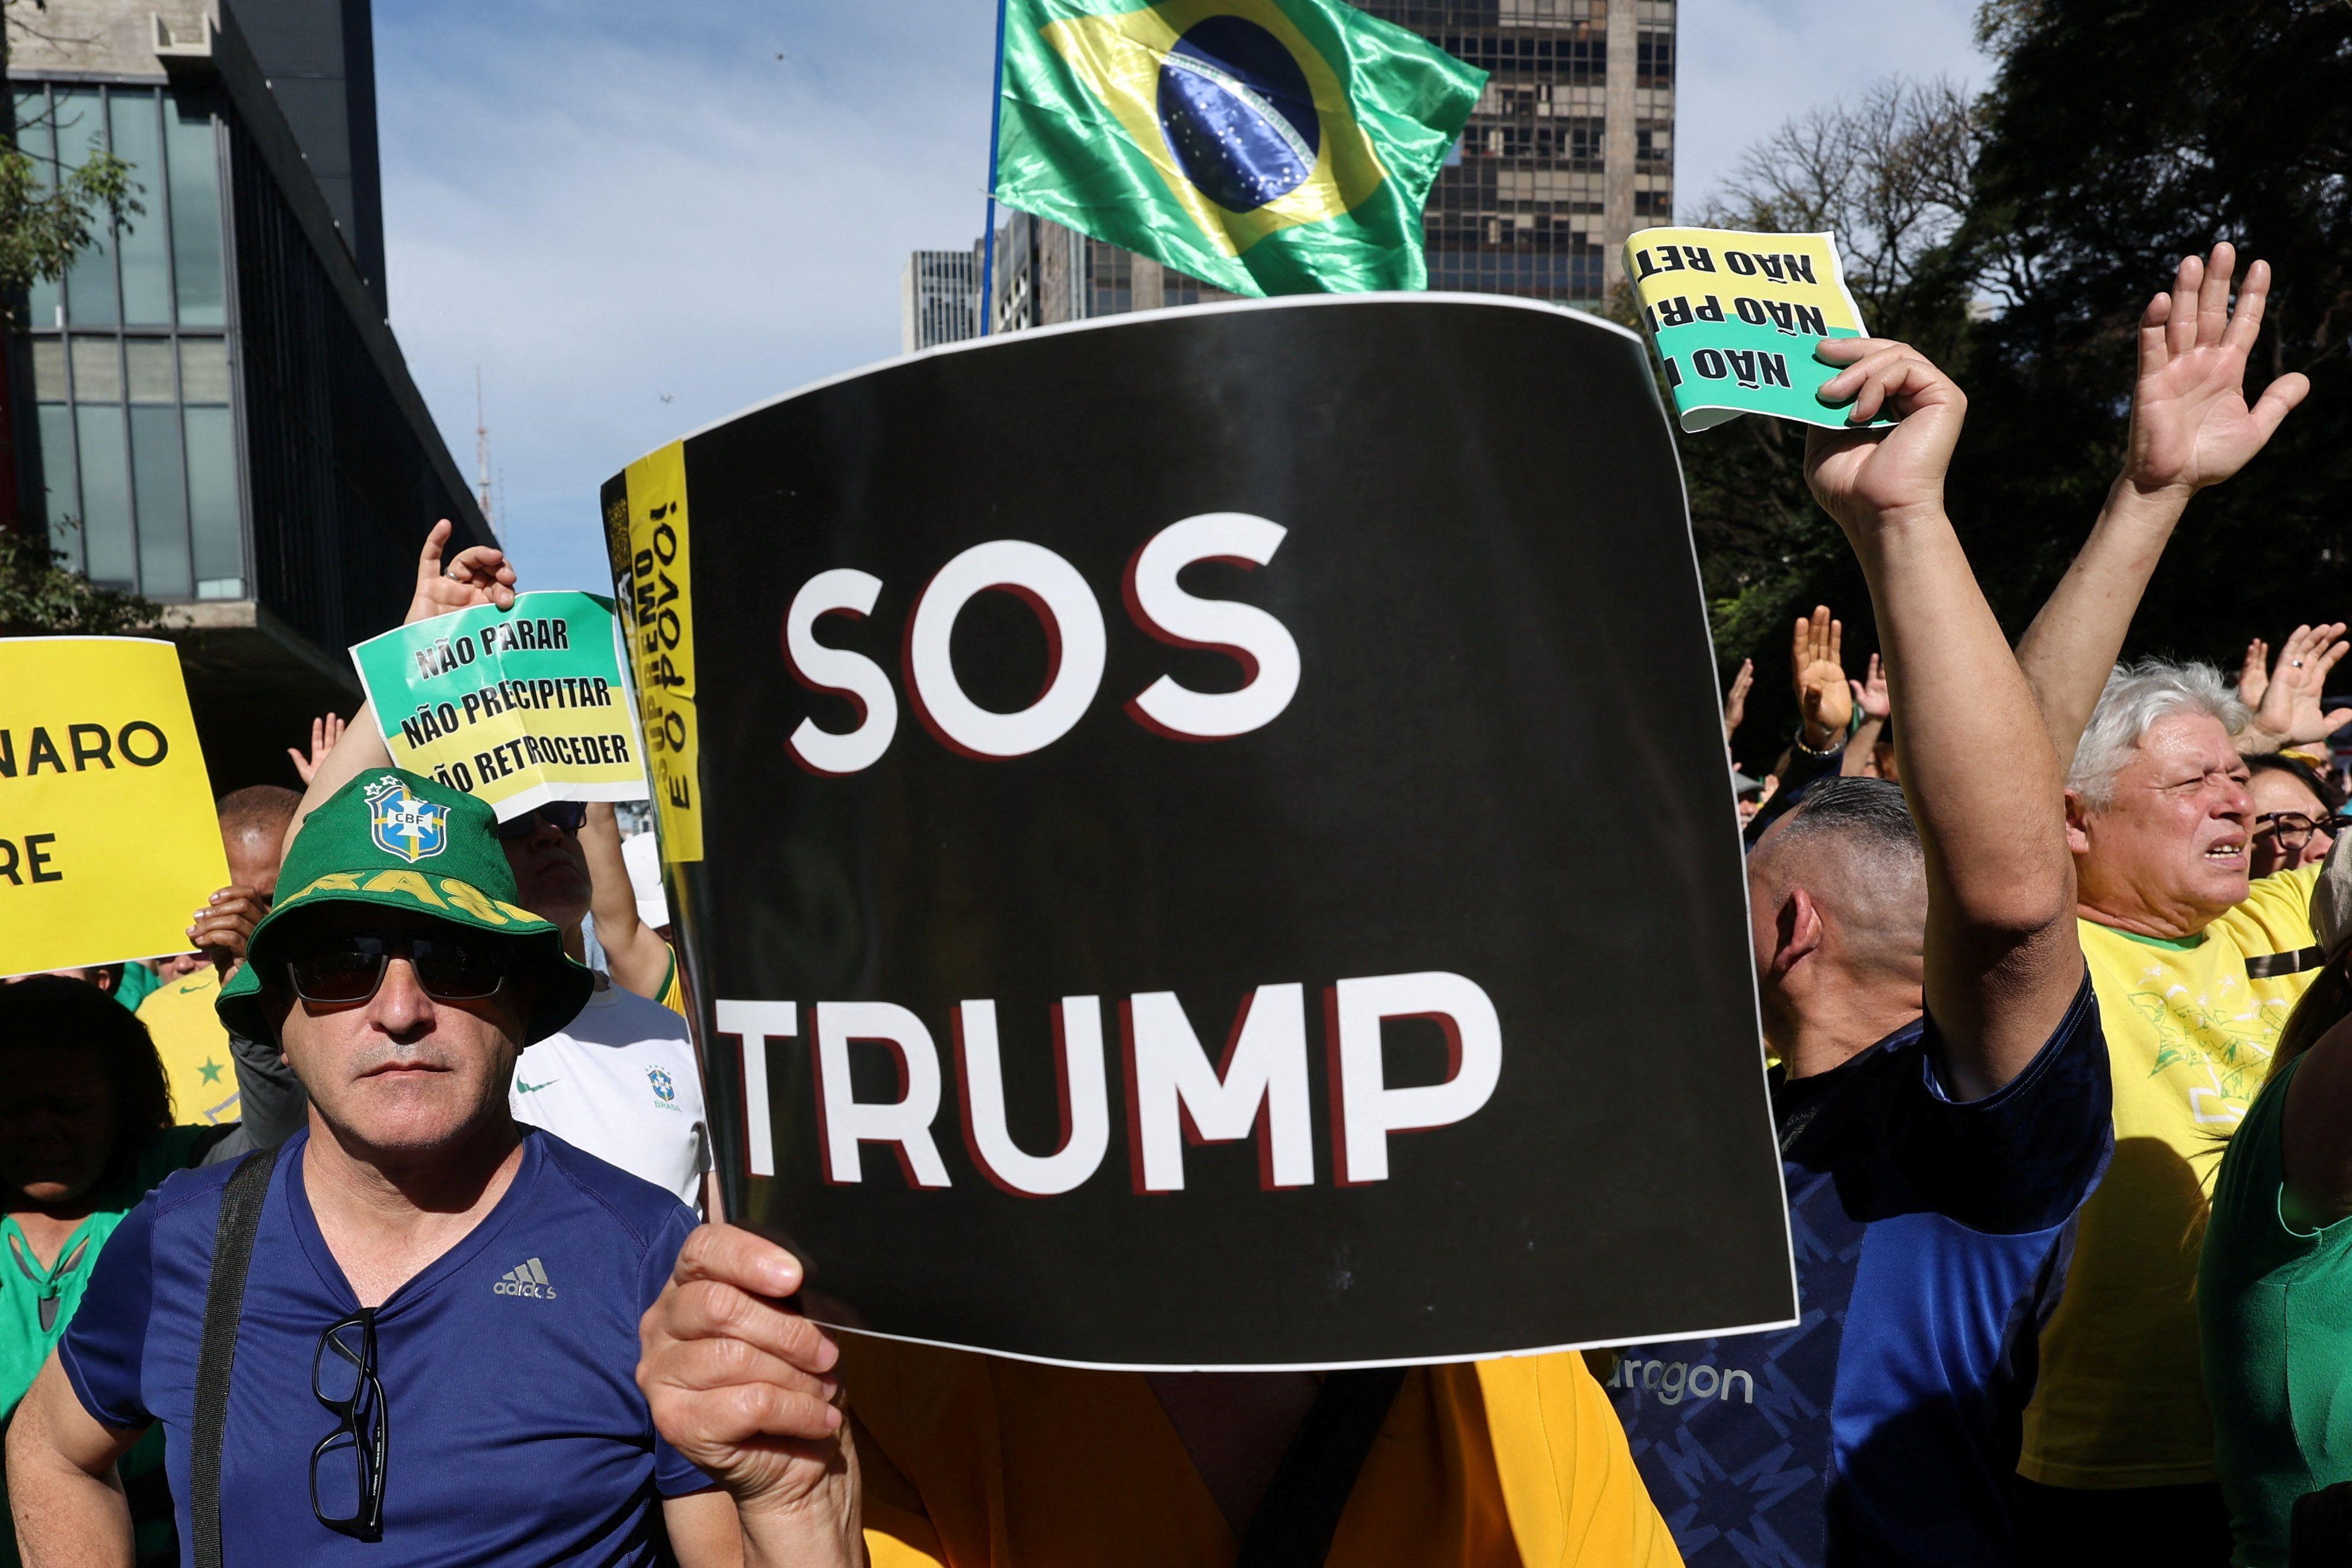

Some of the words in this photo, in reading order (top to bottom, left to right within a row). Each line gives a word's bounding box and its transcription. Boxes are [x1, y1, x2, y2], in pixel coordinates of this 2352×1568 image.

[1635, 245, 1717, 284] RET
[1724, 251, 1817, 284] NÃO
[1734, 297, 1828, 337] NÃO
[1692, 349, 1791, 389] NÃO
[650, 501, 685, 689] POVO!
[416, 638, 475, 680] NÃO
[480, 619, 569, 656] PARAR
[635, 548, 667, 785] SUPREMO
[782, 512, 1300, 777] SOS
[401, 703, 459, 750] NÃO
[461, 677, 612, 724] PRECIPITAR
[664, 709, 686, 753] O
[428, 764, 474, 793] ÃO
[474, 735, 630, 785] RETROCEDER
[395, 813, 424, 824] CBF
[654, 1100, 682, 1113] BRASIL
[715, 971, 1503, 1196] TRUMP
